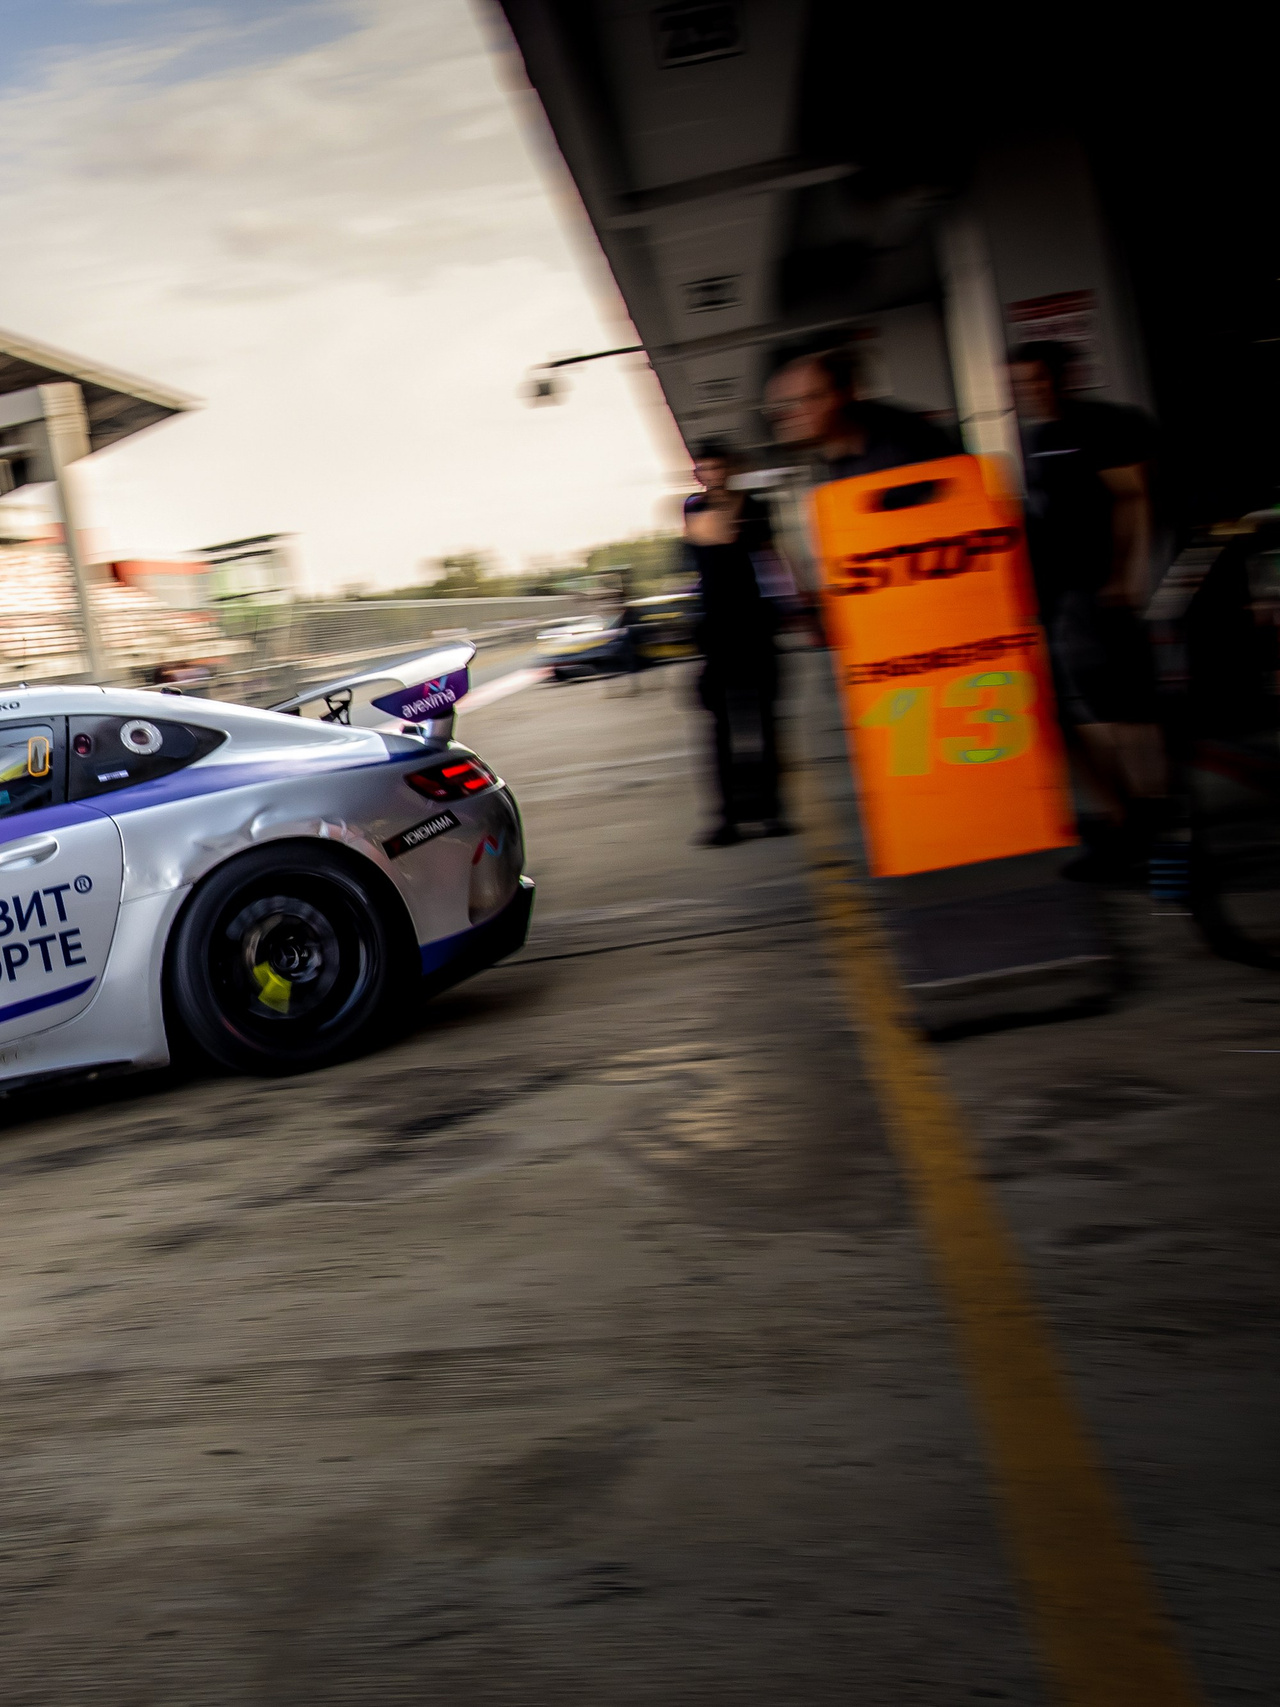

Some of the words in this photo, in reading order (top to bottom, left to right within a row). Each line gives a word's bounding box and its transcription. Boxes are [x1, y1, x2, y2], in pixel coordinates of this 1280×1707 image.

[401, 688, 457, 719] avexima
[858, 670, 1038, 777] 13
[403, 814, 454, 847] YOKOHAMA
